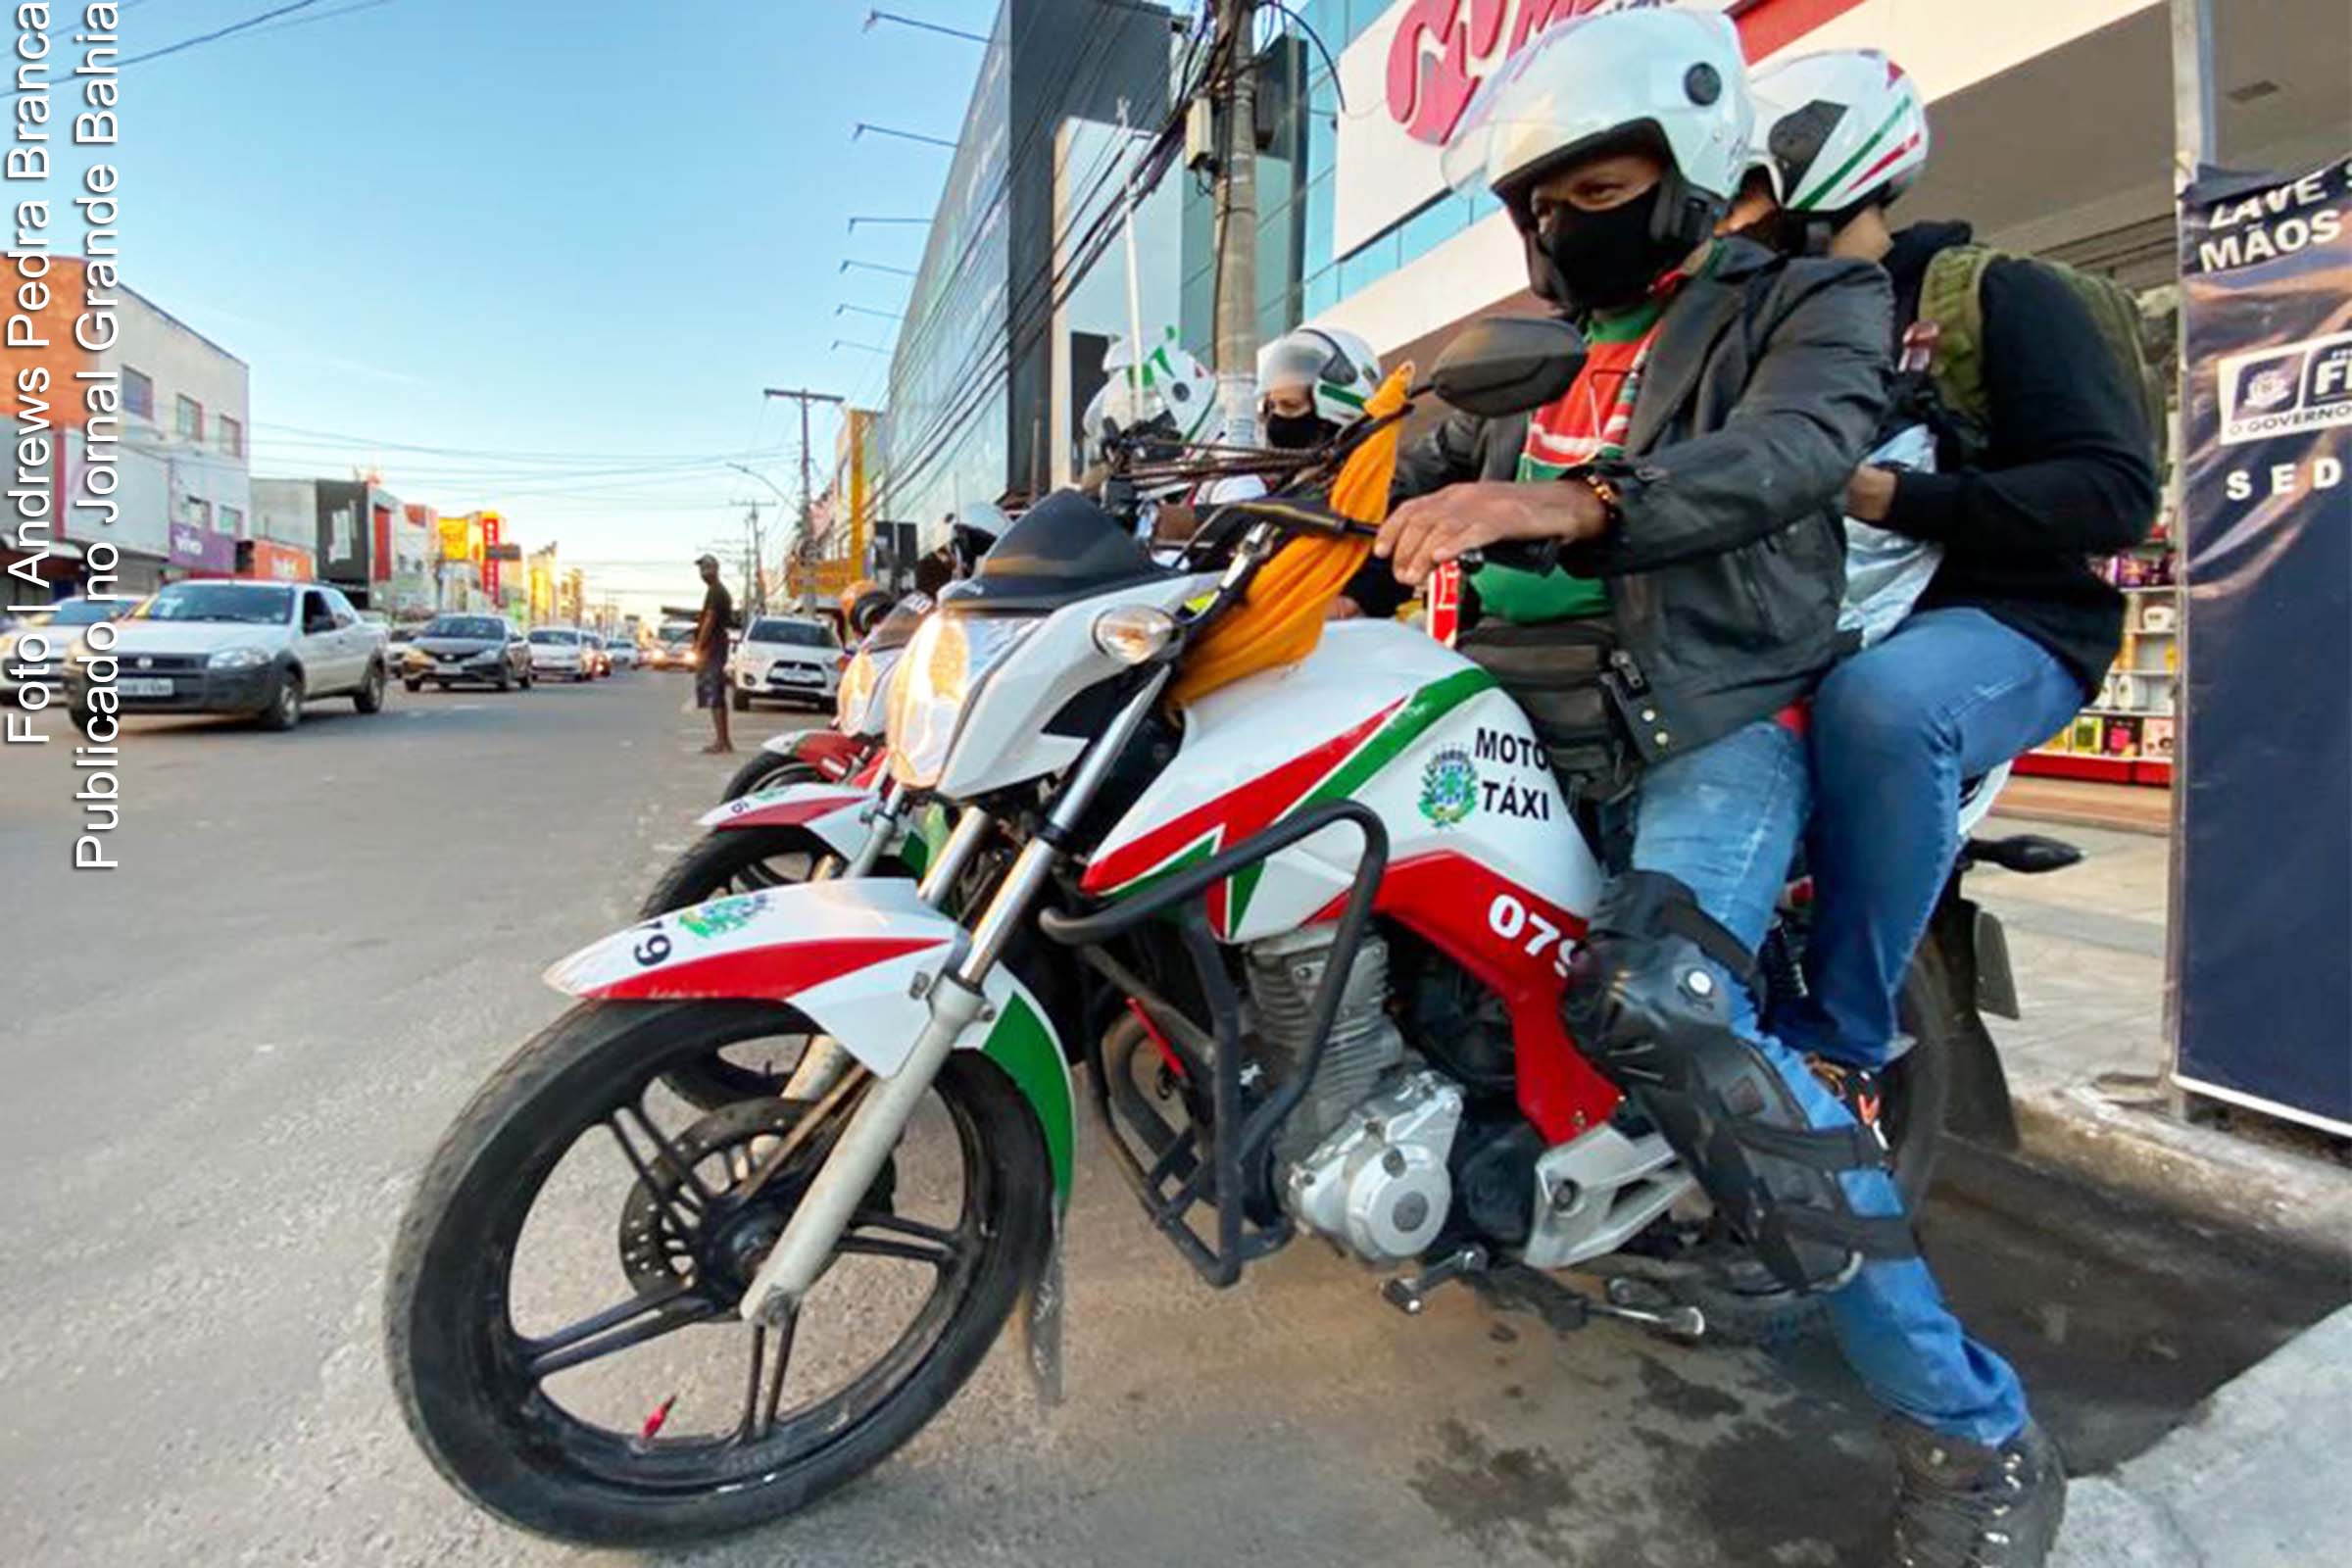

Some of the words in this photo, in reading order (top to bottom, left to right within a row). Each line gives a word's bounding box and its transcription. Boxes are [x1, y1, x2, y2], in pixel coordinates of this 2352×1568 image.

[2209, 170, 2328, 229] LAVE
[2200, 209, 2342, 273] MÃOS
[1475, 727, 1551, 771] MOTO
[1482, 775, 1550, 821] TÁXI
